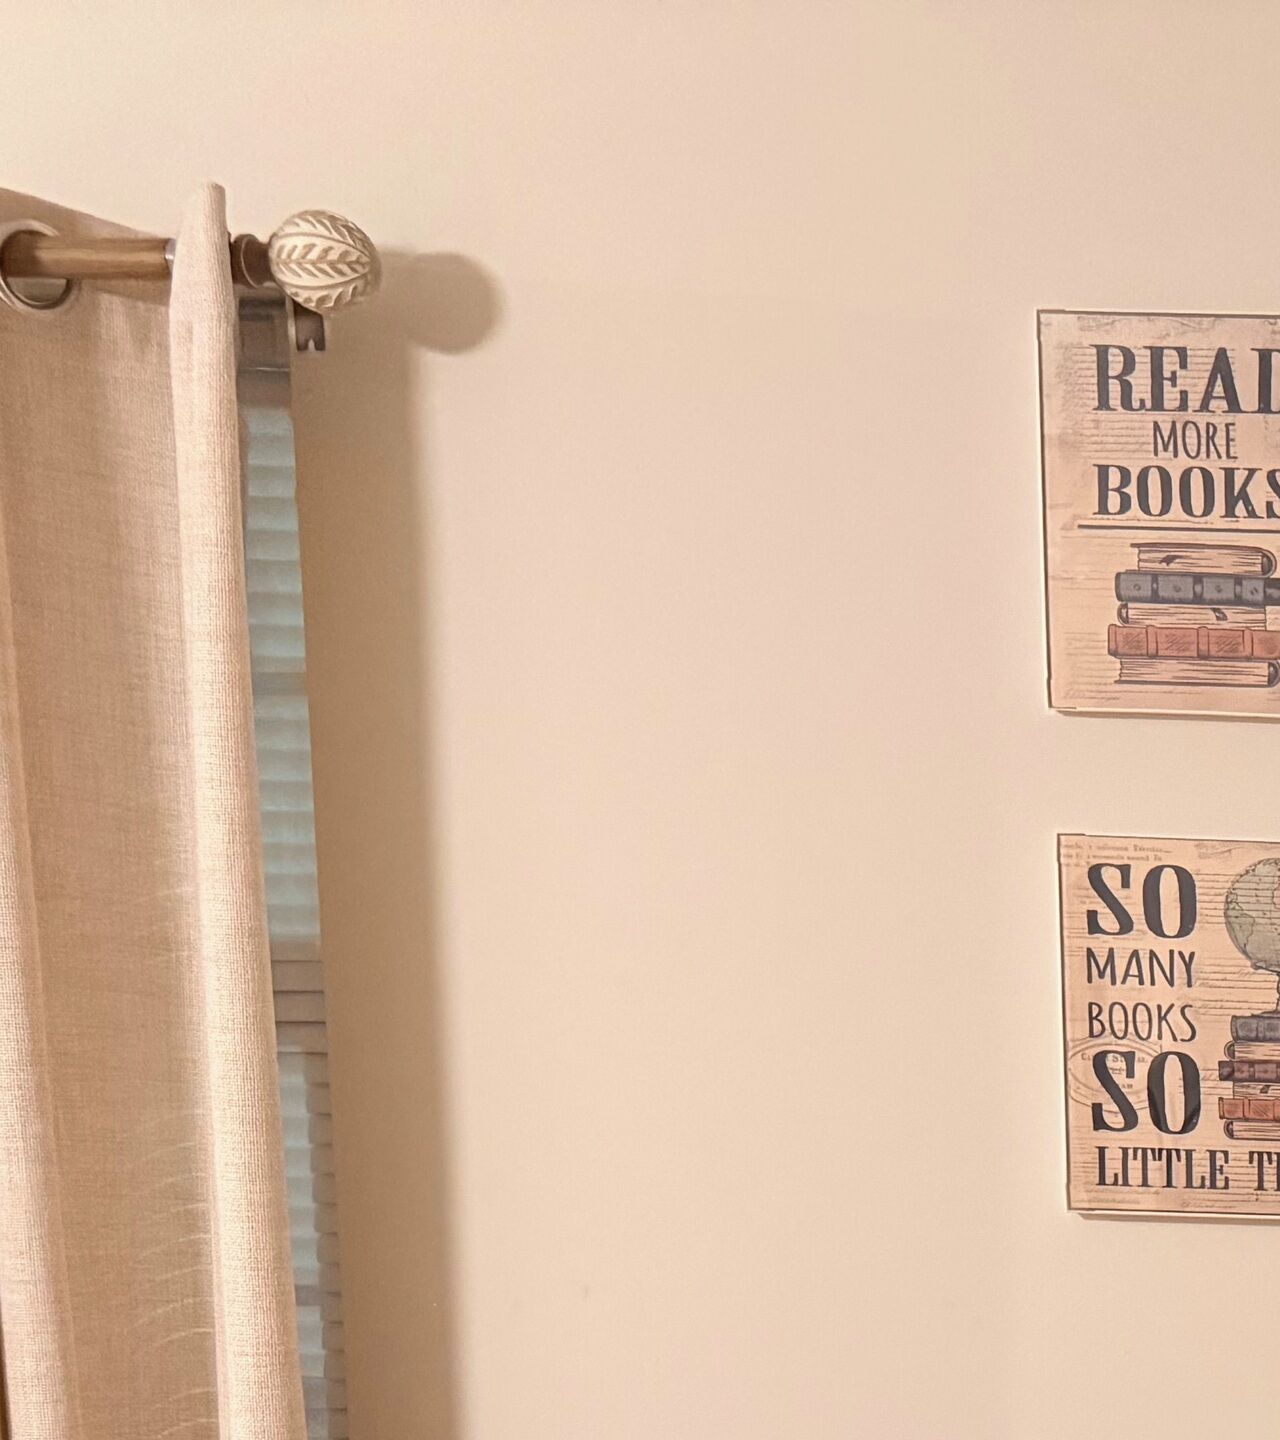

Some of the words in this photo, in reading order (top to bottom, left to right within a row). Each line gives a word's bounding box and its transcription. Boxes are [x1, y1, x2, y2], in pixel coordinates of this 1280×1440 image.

[1152, 421, 1238, 460] MORE
[1087, 863, 1197, 939] SO
[1086, 947, 1195, 988] MANY
[1088, 1002, 1197, 1042] BOOKS
[1091, 1050, 1201, 1134] SO
[1096, 1146, 1229, 1188] LITTLE
